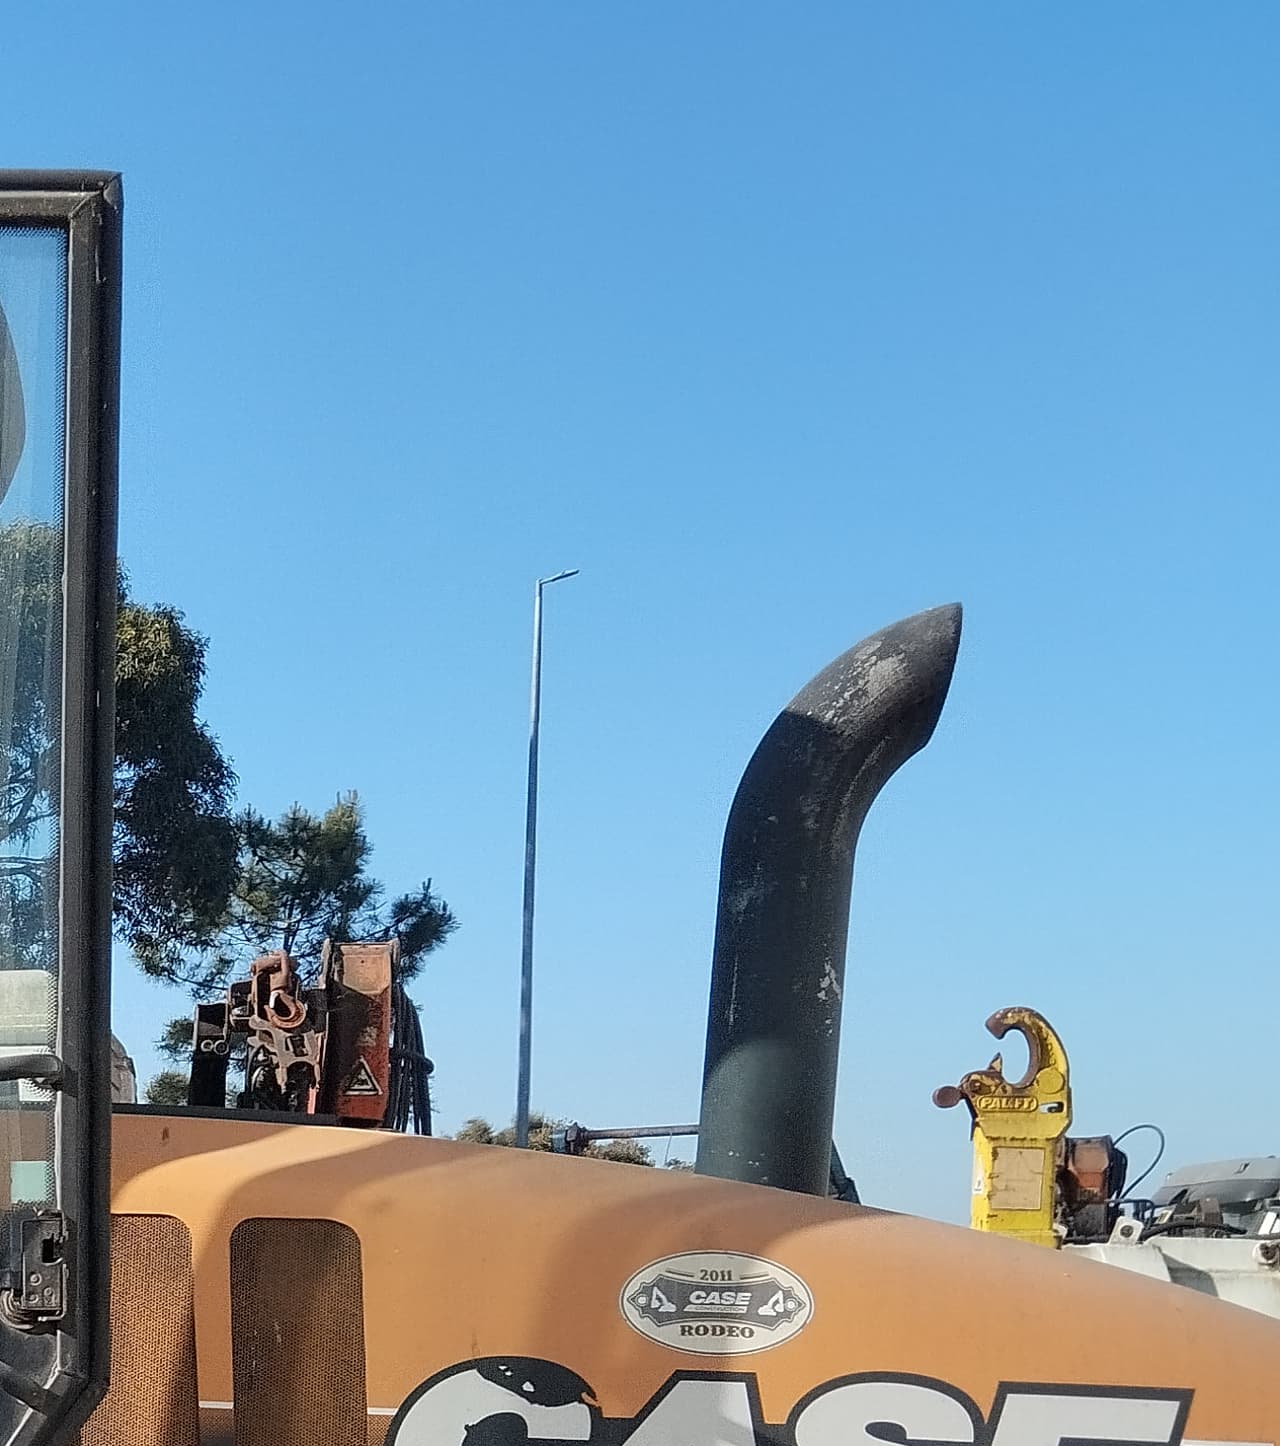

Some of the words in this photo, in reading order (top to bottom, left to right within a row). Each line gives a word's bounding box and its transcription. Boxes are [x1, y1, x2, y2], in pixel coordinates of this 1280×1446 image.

[699, 1269, 733, 1282] 2011
[689, 1290, 753, 1306] CASE
[679, 1324, 755, 1339] RODEO
